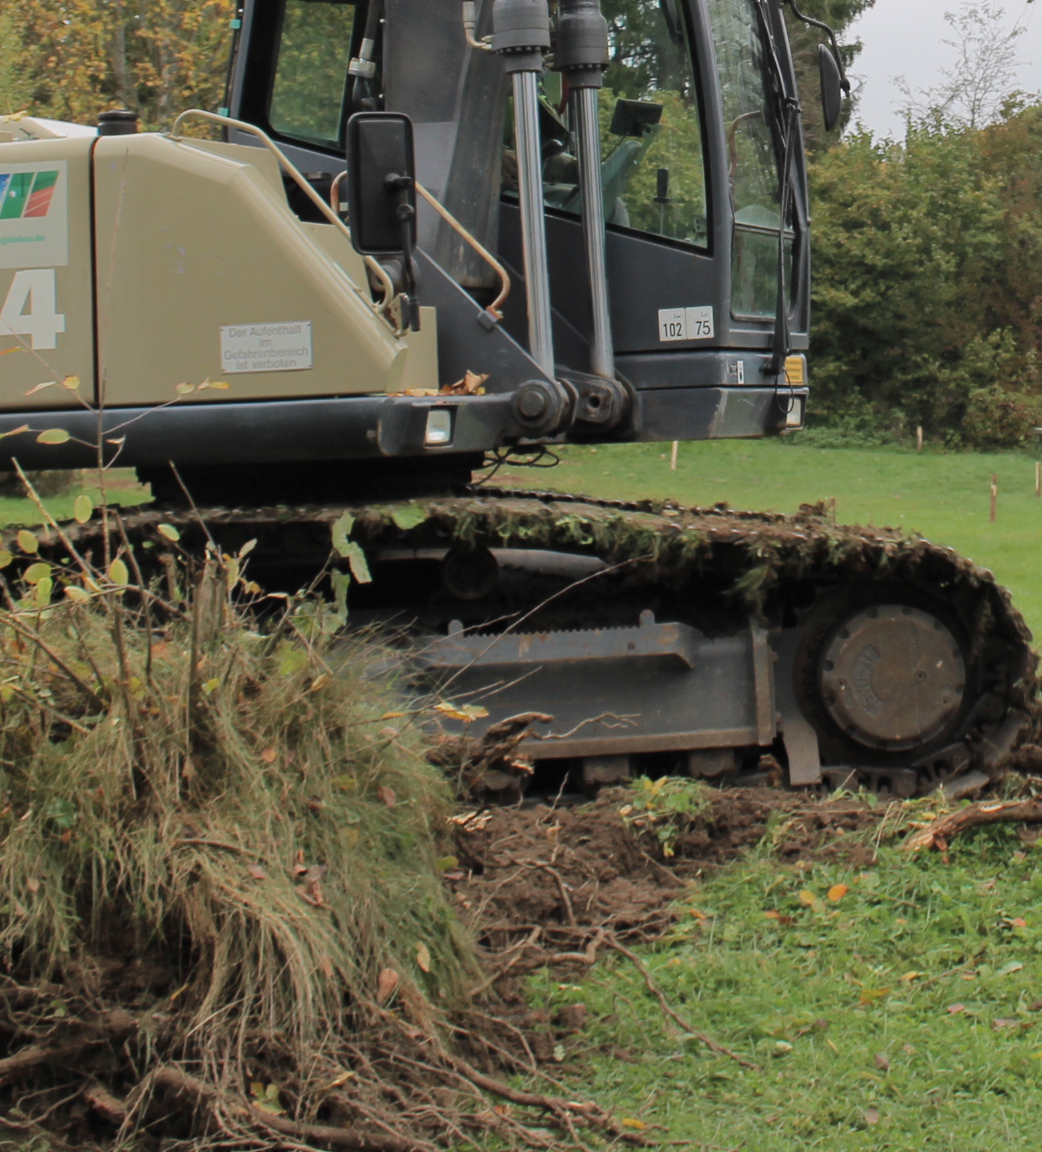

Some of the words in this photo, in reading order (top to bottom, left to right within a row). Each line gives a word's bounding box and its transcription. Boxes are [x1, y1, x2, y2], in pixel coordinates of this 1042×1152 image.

[0, 268, 66, 350] 4
[228, 328, 247, 338] Der
[250, 324, 302, 336] Aufenthalt
[663, 322, 682, 338] 102
[695, 320, 711, 335] 75
[258, 338, 272, 347] im
[223, 346, 309, 360] Gefahrenbereich
[235, 360, 248, 370] ist
[251, 358, 297, 369] verboten
